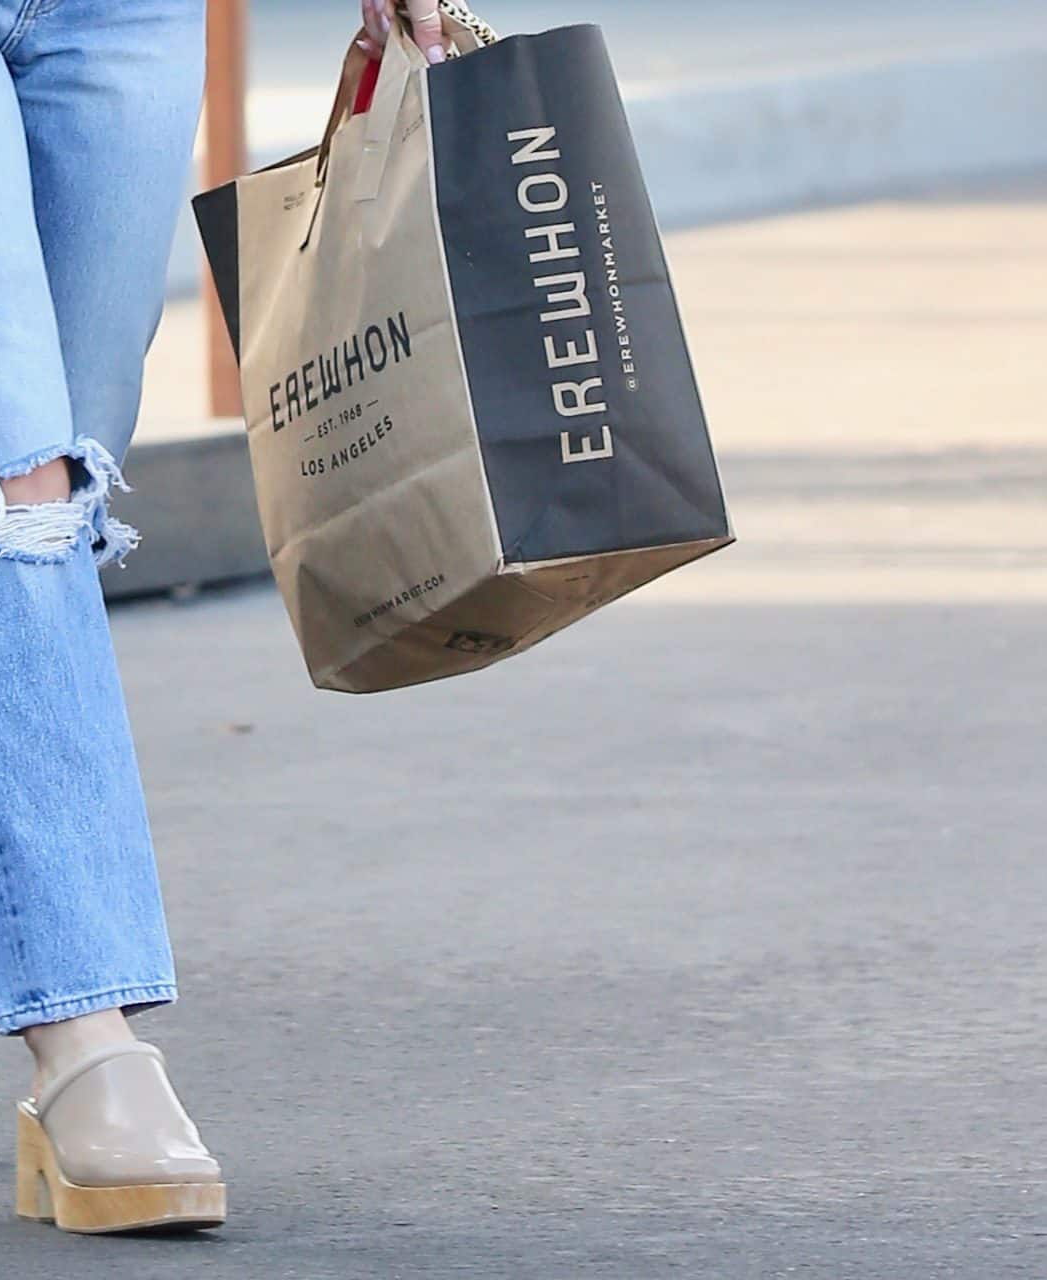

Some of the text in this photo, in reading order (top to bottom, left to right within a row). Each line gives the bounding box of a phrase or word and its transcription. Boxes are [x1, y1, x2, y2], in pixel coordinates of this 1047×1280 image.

[507, 126, 614, 464] EREWHON
[590, 181, 639, 393] @EREWHONMARKET
[269, 311, 411, 432] EREWHON
[317, 403, 363, 438] EST. 1968
[301, 414, 394, 477] LOS ANGELES
